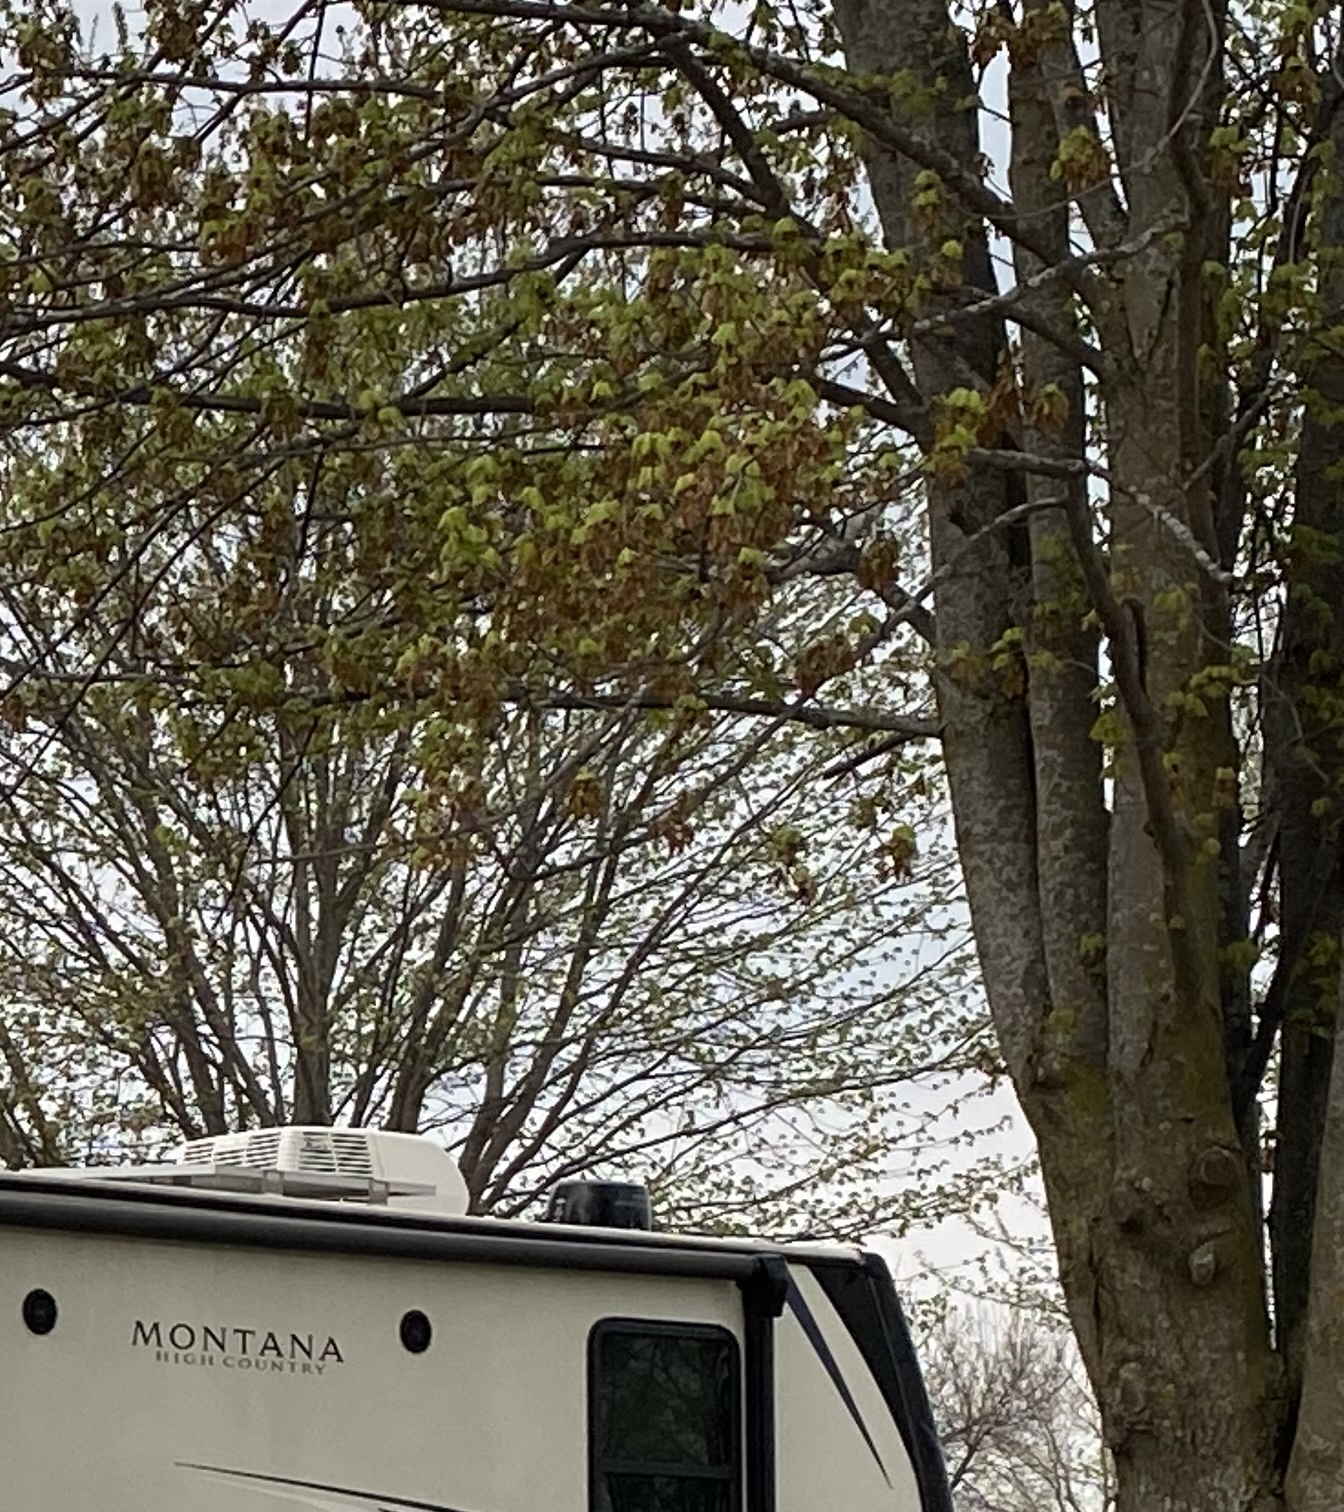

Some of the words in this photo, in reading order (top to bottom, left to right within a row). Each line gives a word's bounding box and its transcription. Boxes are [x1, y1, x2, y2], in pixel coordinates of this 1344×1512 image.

[131, 1320, 344, 1363] MONTANA
[156, 1349, 214, 1367] HIGH
[222, 1355, 327, 1376] COUNTRY
